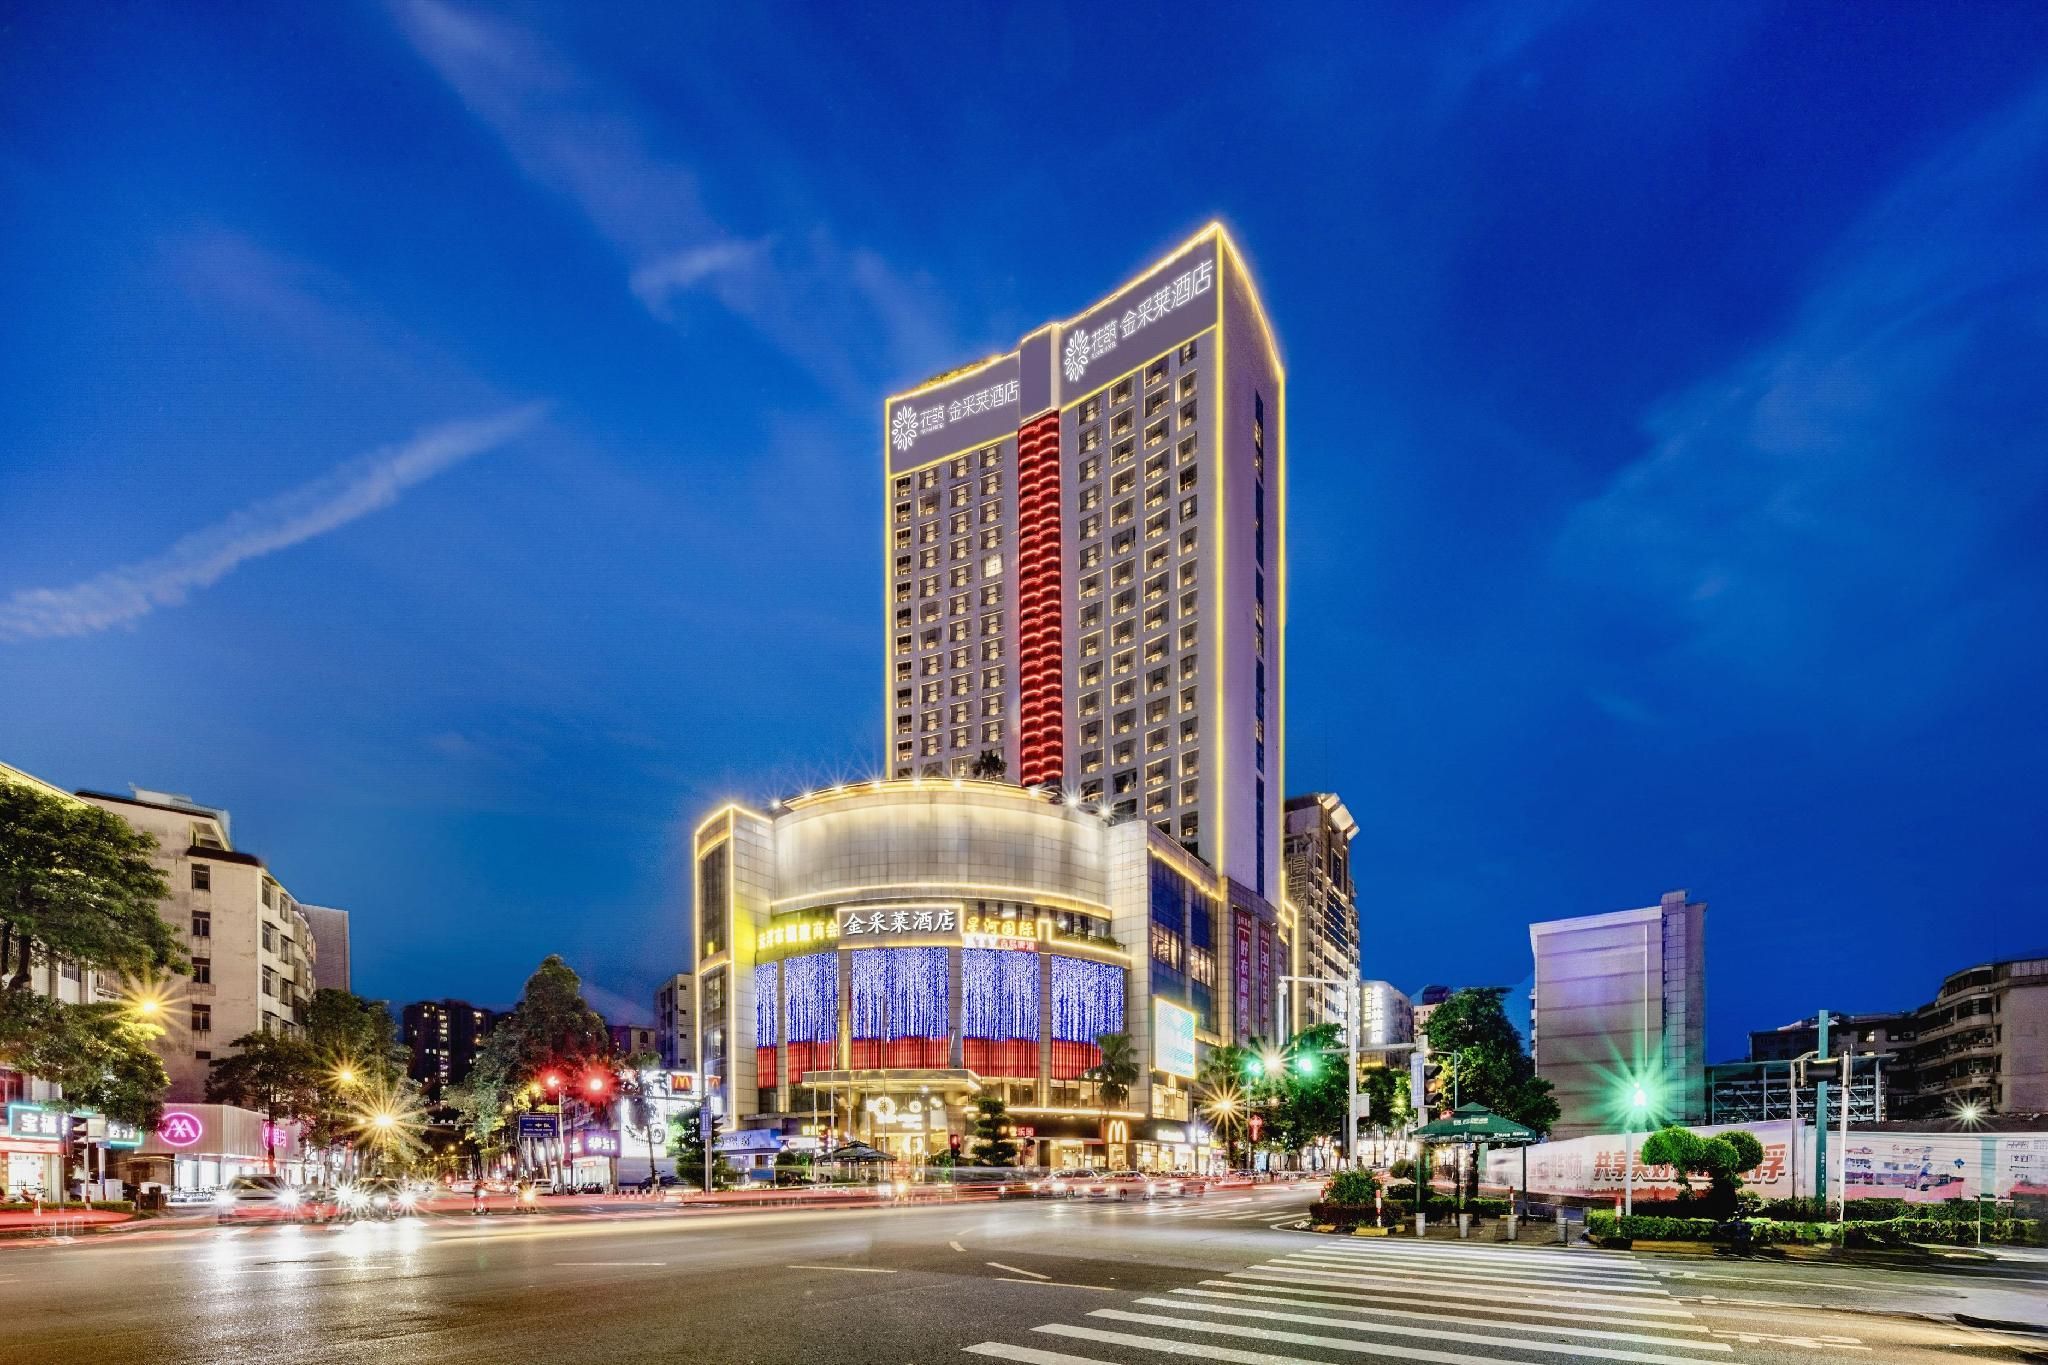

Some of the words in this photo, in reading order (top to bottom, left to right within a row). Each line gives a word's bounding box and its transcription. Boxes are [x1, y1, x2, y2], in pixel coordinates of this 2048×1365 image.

[1120, 260, 1213, 339] 金采莱酒店
[948, 380, 1020, 422] 金采莱酒店
[843, 909, 955, 935] 金采莱酒店
[966, 916, 1034, 937] 星河国际
